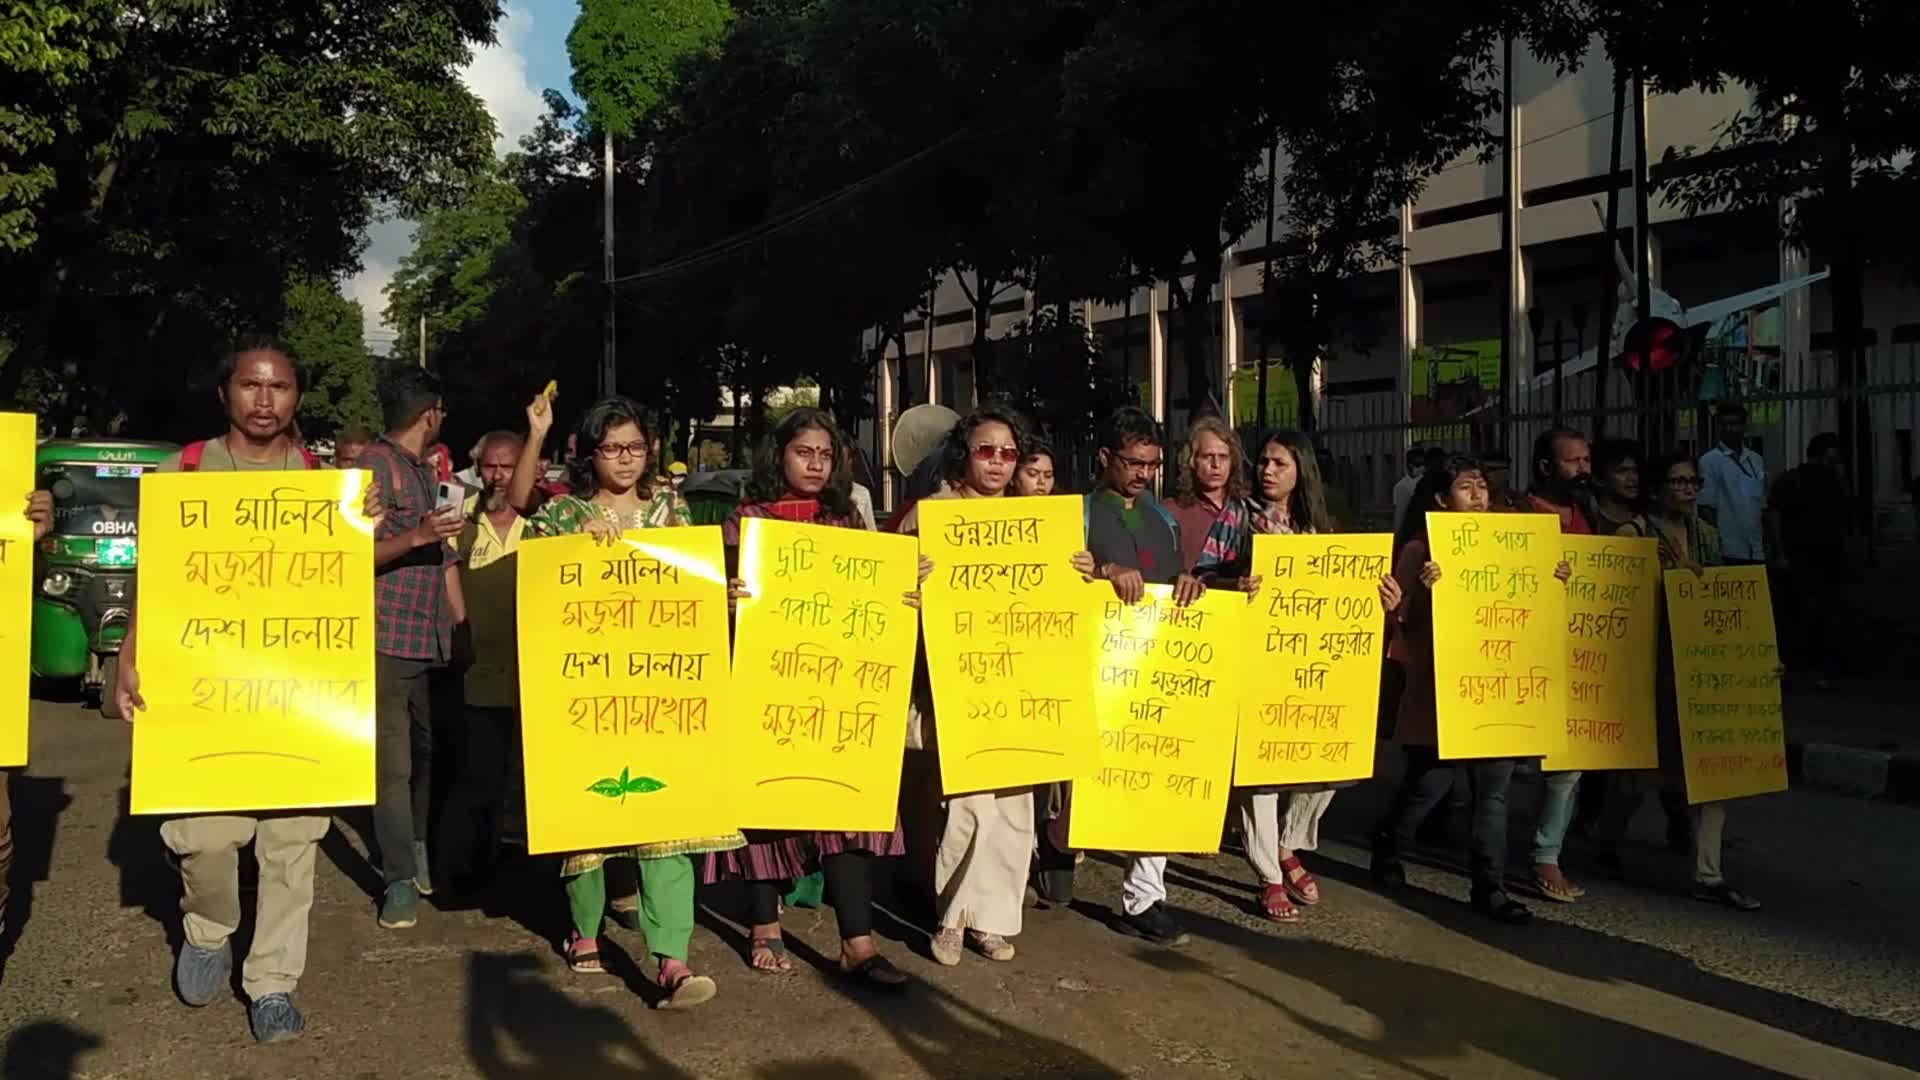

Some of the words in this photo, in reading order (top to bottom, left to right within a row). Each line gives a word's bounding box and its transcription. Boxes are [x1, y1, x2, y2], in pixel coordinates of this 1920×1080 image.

[180, 499, 208, 529] চা
[234, 485, 341, 537] মালিক
[943, 514, 1046, 547] উন্নয়নের
[1451, 521, 1481, 557] দুটি
[1492, 527, 1538, 552] পাতা
[184, 535, 286, 600] মজুরী
[286, 550, 354, 588] চোর
[559, 562, 583, 588] চা
[774, 537, 821, 583] দুটি
[831, 554, 885, 587] পাতা
[1274, 554, 1295, 579] চা
[1305, 544, 1389, 582] শ্রমিকদের
[1456, 562, 1502, 593] একটি
[1268, 586, 1330, 622] দৈনিক
[1334, 595, 1374, 622] ৩০০
[1565, 575, 1601, 604] াবির
[1679, 580, 1694, 601] চা
[561, 590, 641, 636] মজুরী
[648, 599, 704, 629] চোর
[771, 591, 834, 628] একটি
[954, 611, 974, 637] চা
[986, 601, 1080, 640] শ্রমিকদের
[1104, 600, 1123, 622] চা
[1474, 599, 1533, 631] মালিক
[1567, 606, 1633, 641] সংহতি
[180, 617, 246, 649] দেশ
[262, 615, 361, 651] চালায়
[1100, 625, 1159, 657] দৈনিক
[1164, 639, 1215, 665] ৩০০
[1265, 624, 1309, 657] টাকা
[1318, 624, 1376, 662] মজুরীর
[1479, 638, 1518, 664] করে
[561, 651, 611, 680] দেশ
[628, 651, 712, 682] চালায়
[770, 642, 844, 688] মালিক
[853, 658, 899, 693] করে
[958, 640, 1024, 684] মজুরী
[1294, 661, 1332, 692] দাবি
[191, 676, 369, 719] হারামোর
[1150, 667, 1216, 700] মজুরীর
[1458, 667, 1515, 706] মজুরী
[1515, 666, 1554, 706] চুরি
[568, 694, 708, 736] হারামখোর
[762, 695, 830, 748] মজুরী
[831, 701, 881, 753] চুরি
[967, 699, 1009, 721] ১২০
[1020, 688, 1073, 728] টাকা
[1129, 697, 1172, 725] দাবি
[1257, 738, 1319, 764] মানতে
[1319, 740, 1357, 763] হবে
